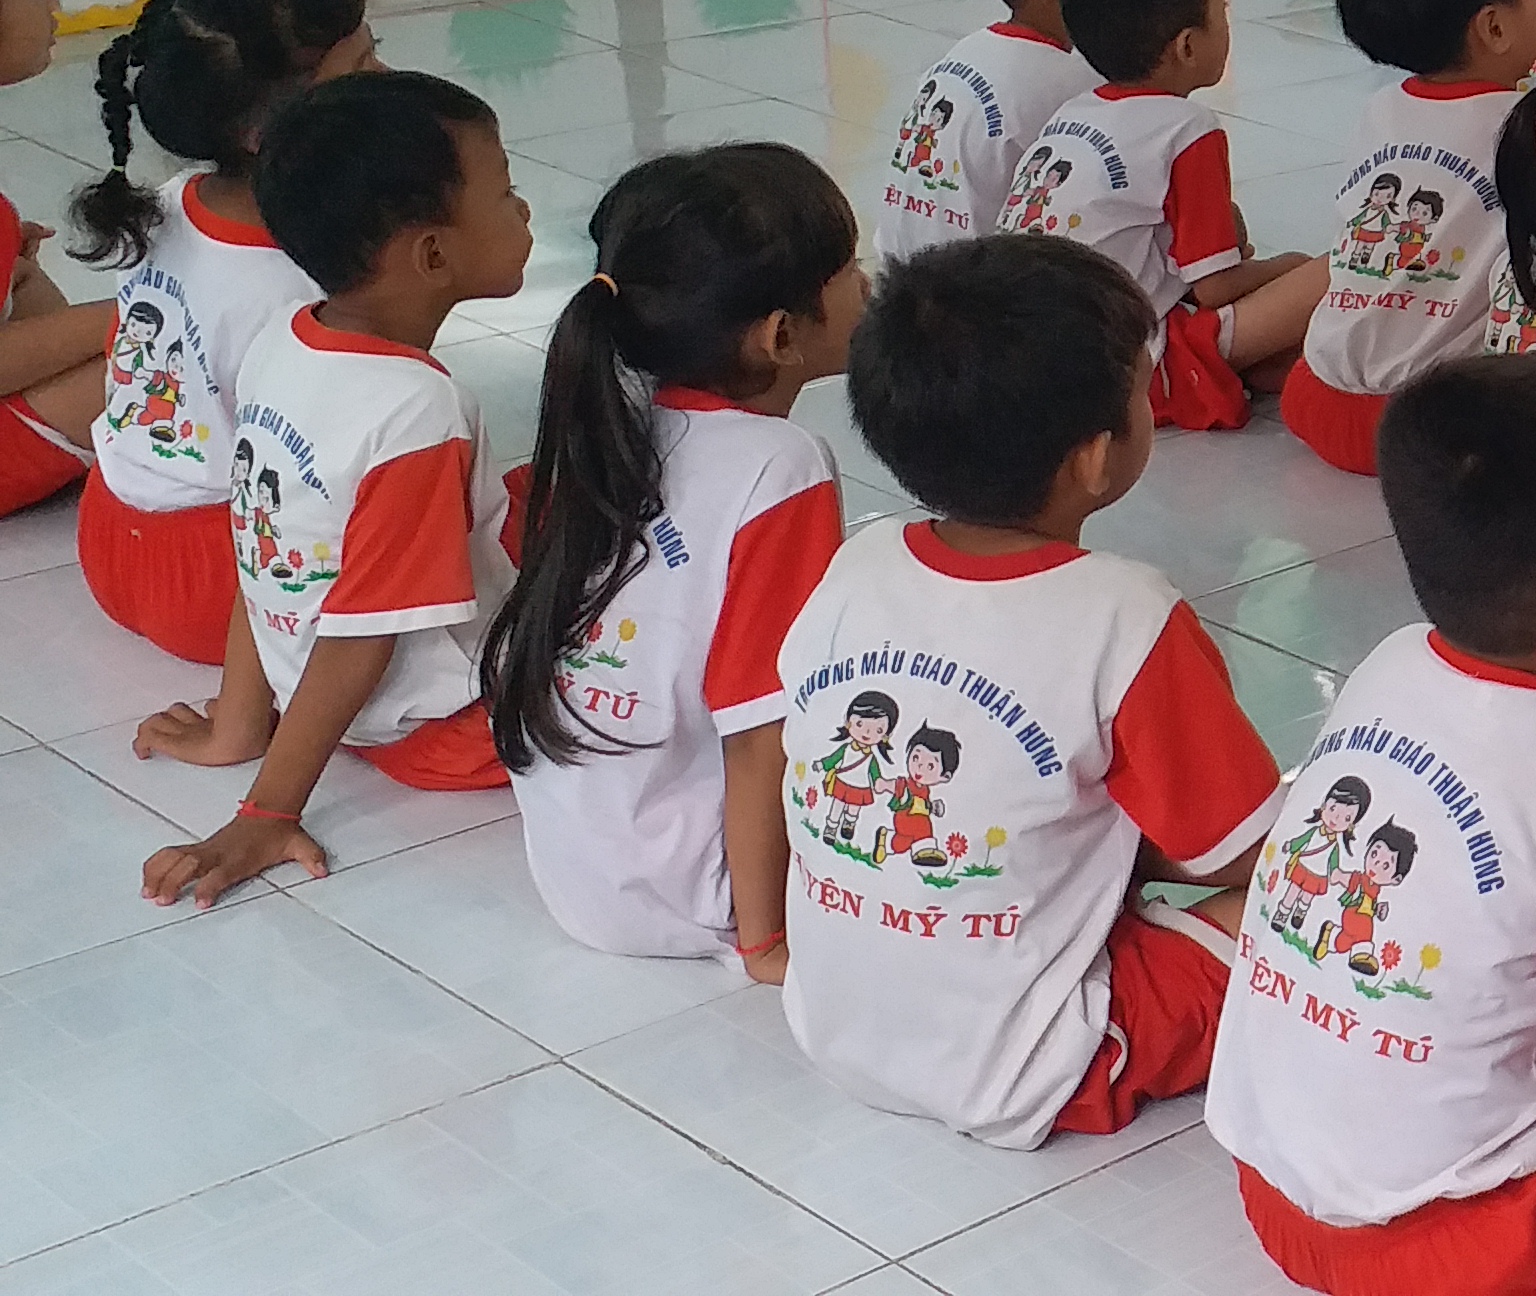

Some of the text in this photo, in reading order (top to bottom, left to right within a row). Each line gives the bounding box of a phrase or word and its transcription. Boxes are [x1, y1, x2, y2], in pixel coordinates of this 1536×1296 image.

[1400, 142, 1432, 161] GIÁO
[1434, 148, 1479, 184] THUẬN
[1328, 288, 1371, 312] YỆN
[652, 516, 690, 570] HƯNG
[584, 686, 640, 720] TÚ
[860, 640, 906, 676] MẪU
[910, 653, 957, 687] GIÁO
[958, 667, 1026, 729] THUẬN
[1015, 720, 1064, 778] HƯNG
[1346, 717, 1393, 754] MẪU
[1389, 736, 1436, 776] GIÁO
[1427, 762, 1486, 832] THUẬN
[1466, 830, 1505, 895] HƯNG
[880, 902, 948, 938] MỸ
[961, 905, 1022, 938] TÚ
[1301, 993, 1361, 1043] MỸ
[1372, 1028, 1435, 1064] TÚ
